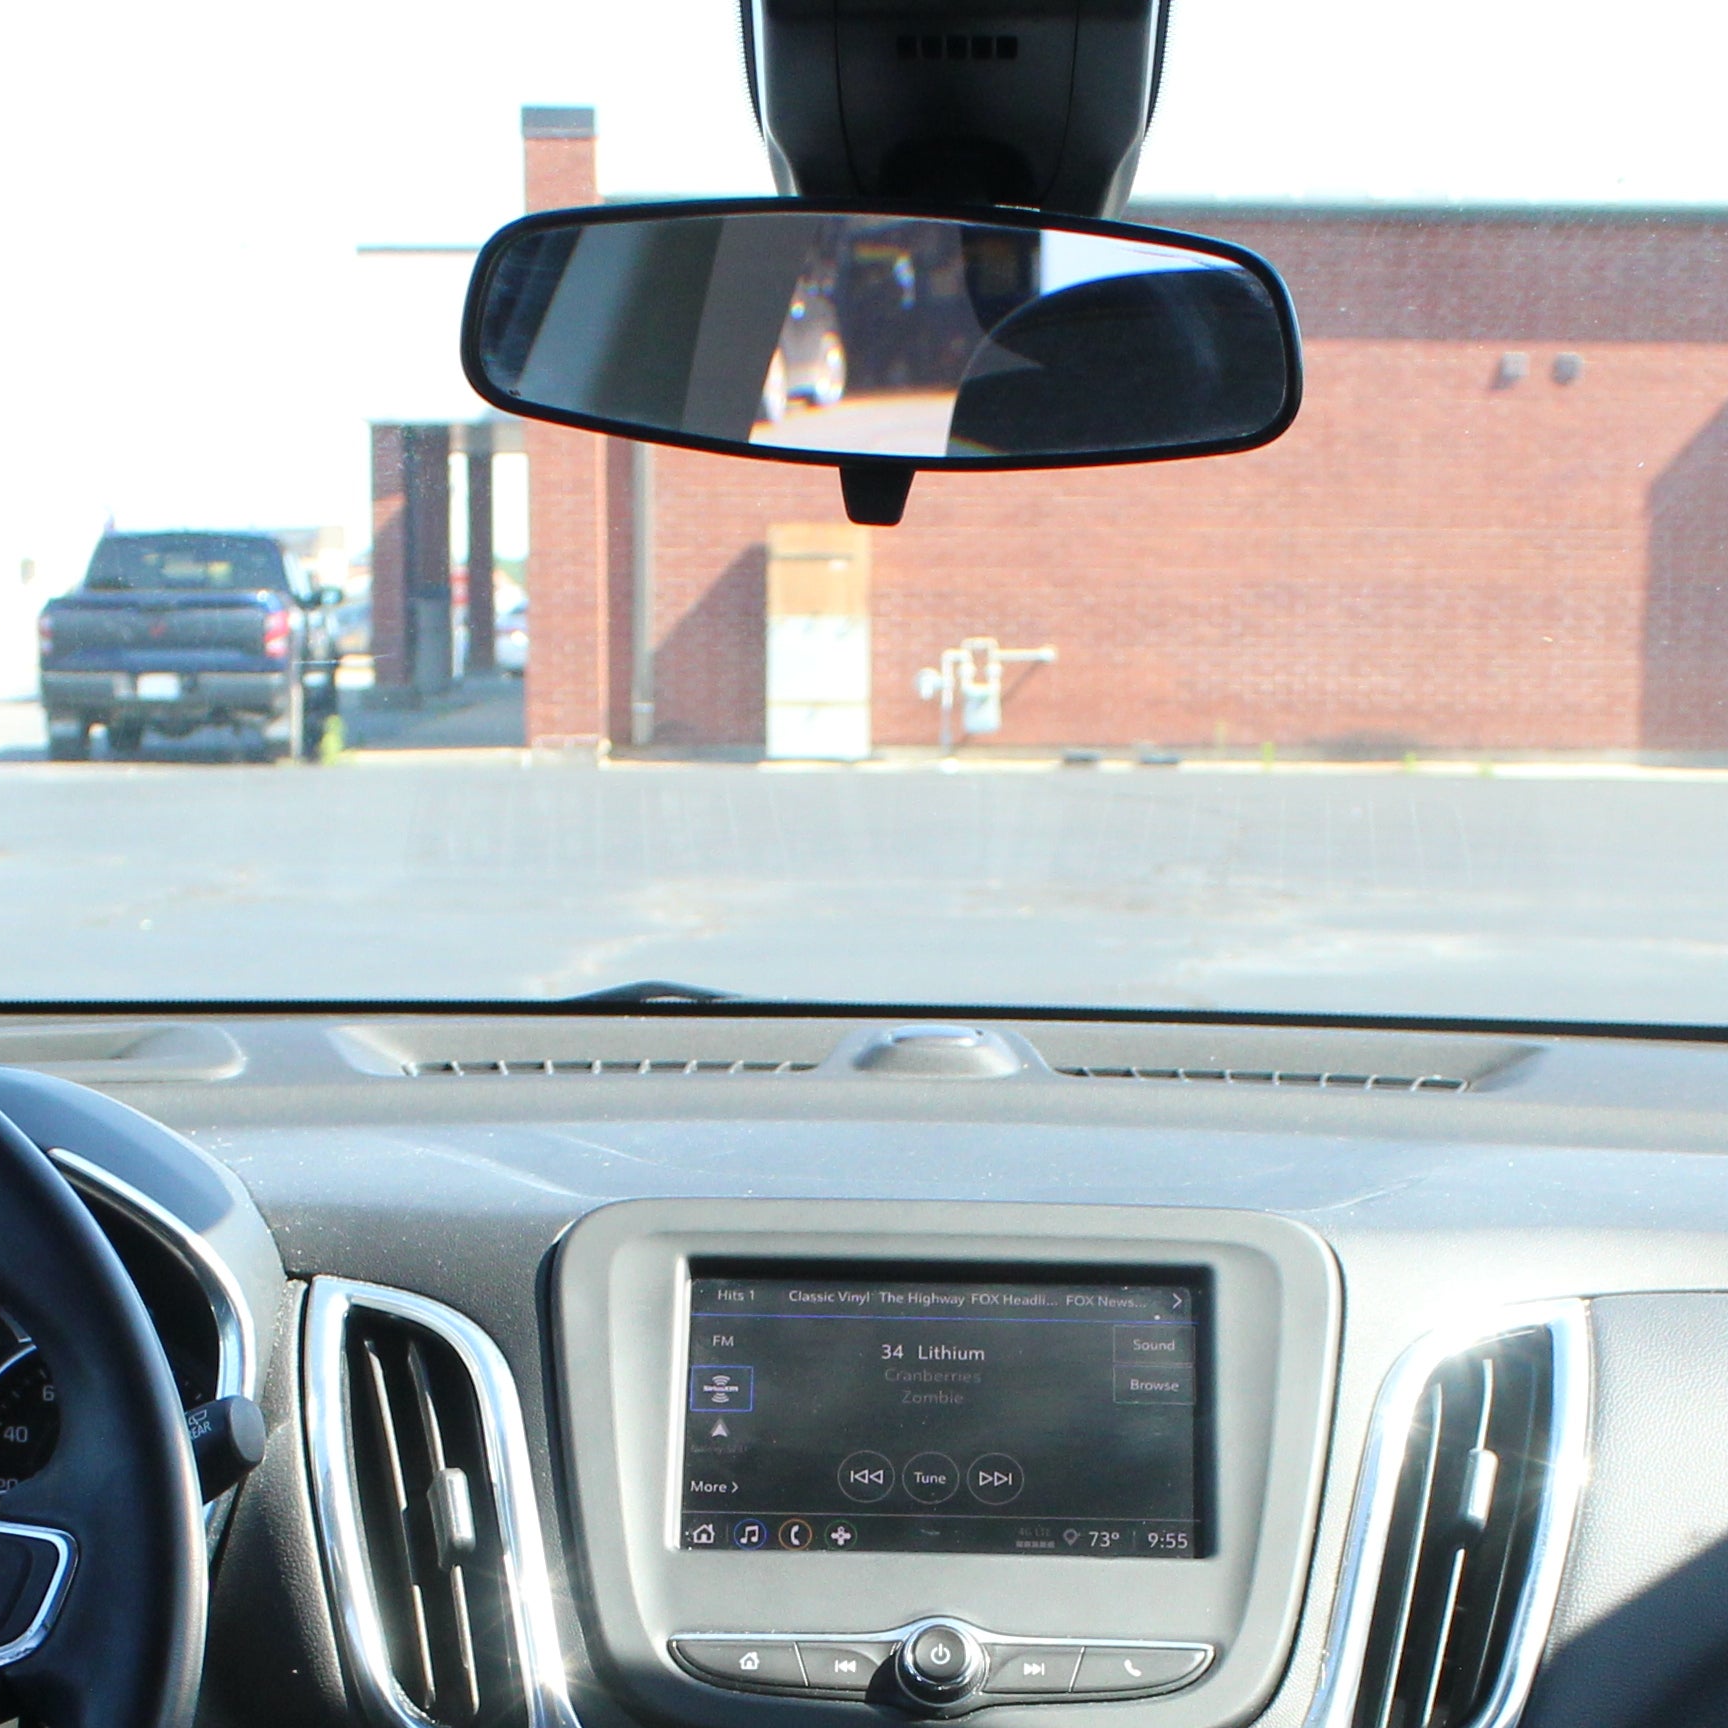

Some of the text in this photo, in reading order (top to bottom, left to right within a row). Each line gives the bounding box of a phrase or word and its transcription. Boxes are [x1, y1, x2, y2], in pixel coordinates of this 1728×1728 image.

[718, 1289, 745, 1301] Hits
[788, 1291, 871, 1305] Classic Vinyl
[879, 1291, 965, 1308] The Highway
[971, 1293, 1059, 1307] FOX Headli...
[1066, 1295, 1094, 1307] FOX
[712, 1335, 735, 1347] FM
[1132, 1338, 1176, 1351] Sound
[881, 1344, 985, 1361] 34 Lithium
[884, 1368, 982, 1383] Cranberries
[1129, 1379, 1180, 1392] Browse
[901, 1390, 964, 1405] Zombie
[3, 1426, 28, 1443] 40
[913, 1471, 947, 1484] Tune
[690, 1480, 727, 1494] More
[1147, 1532, 1188, 1549] 9:55
